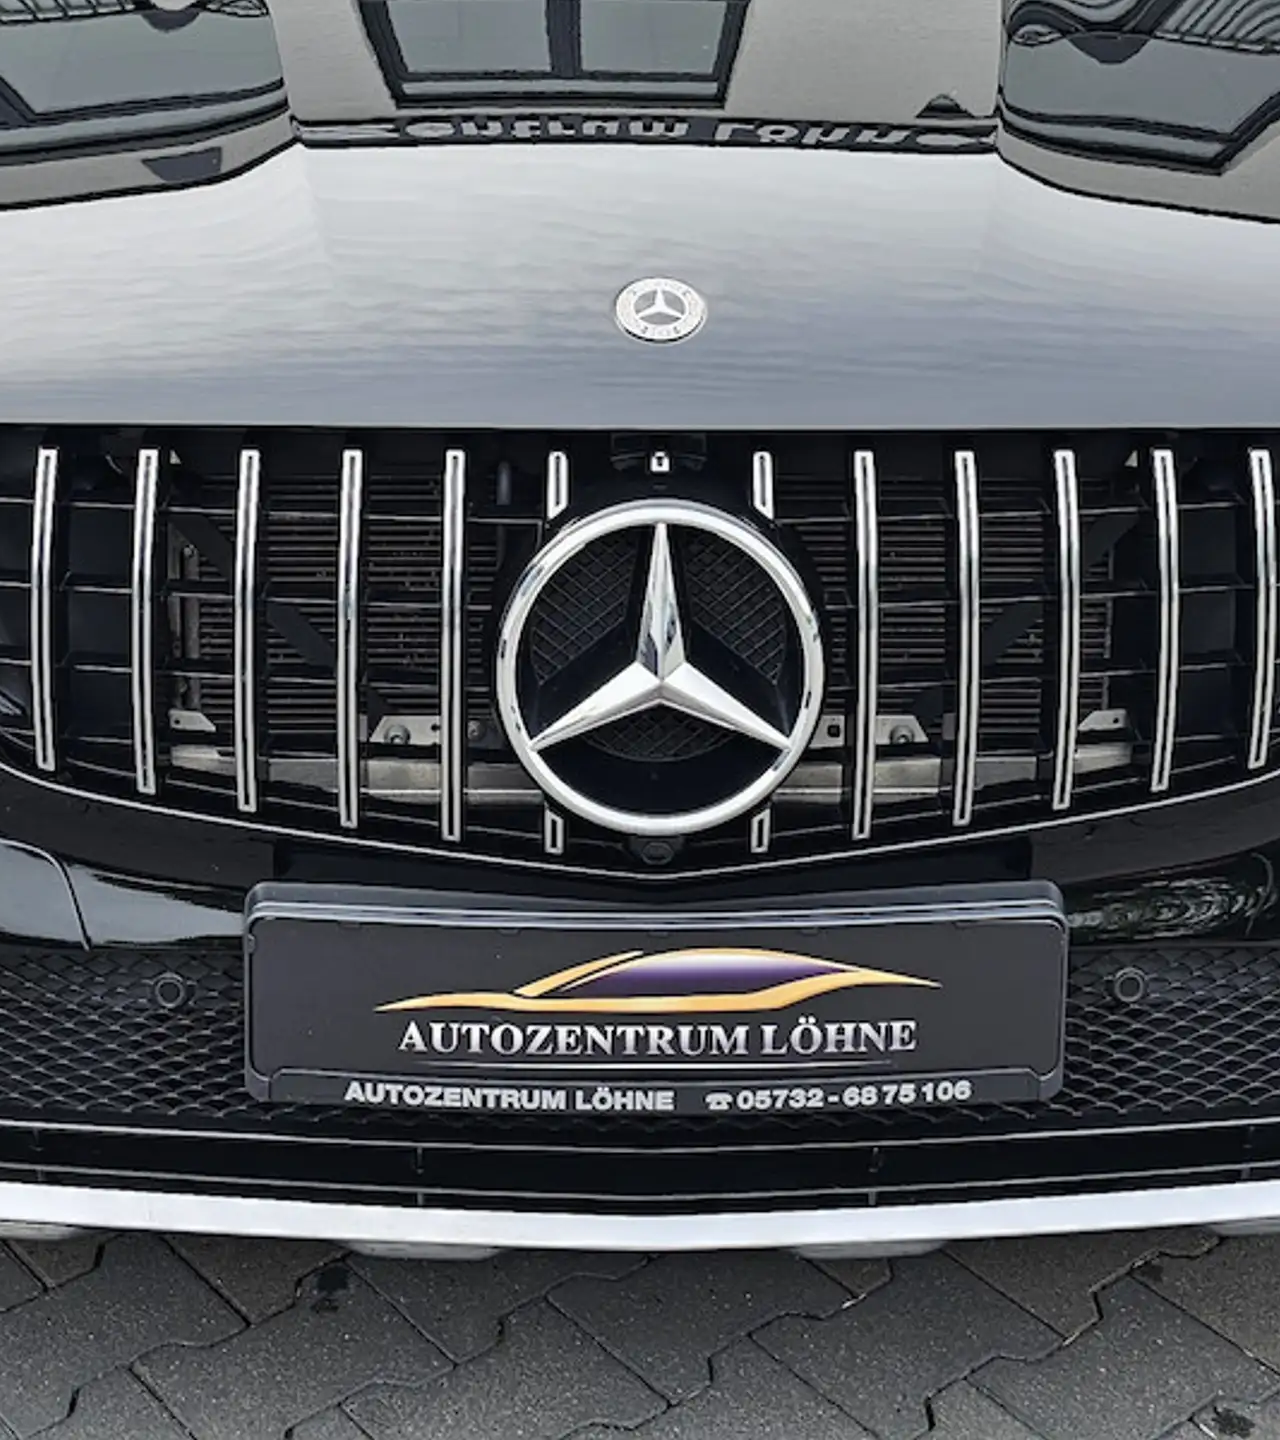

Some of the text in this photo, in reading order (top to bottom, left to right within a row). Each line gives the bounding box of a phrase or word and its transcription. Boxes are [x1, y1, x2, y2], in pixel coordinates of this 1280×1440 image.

[398, 1015, 917, 1056] AUTOZENTRUM LÖHNE
[344, 1080, 566, 1110] AUTOZENTRUM
[575, 1086, 675, 1111] LÖHNE
[882, 1083, 916, 1105] 75
[920, 1080, 972, 1102] 106
